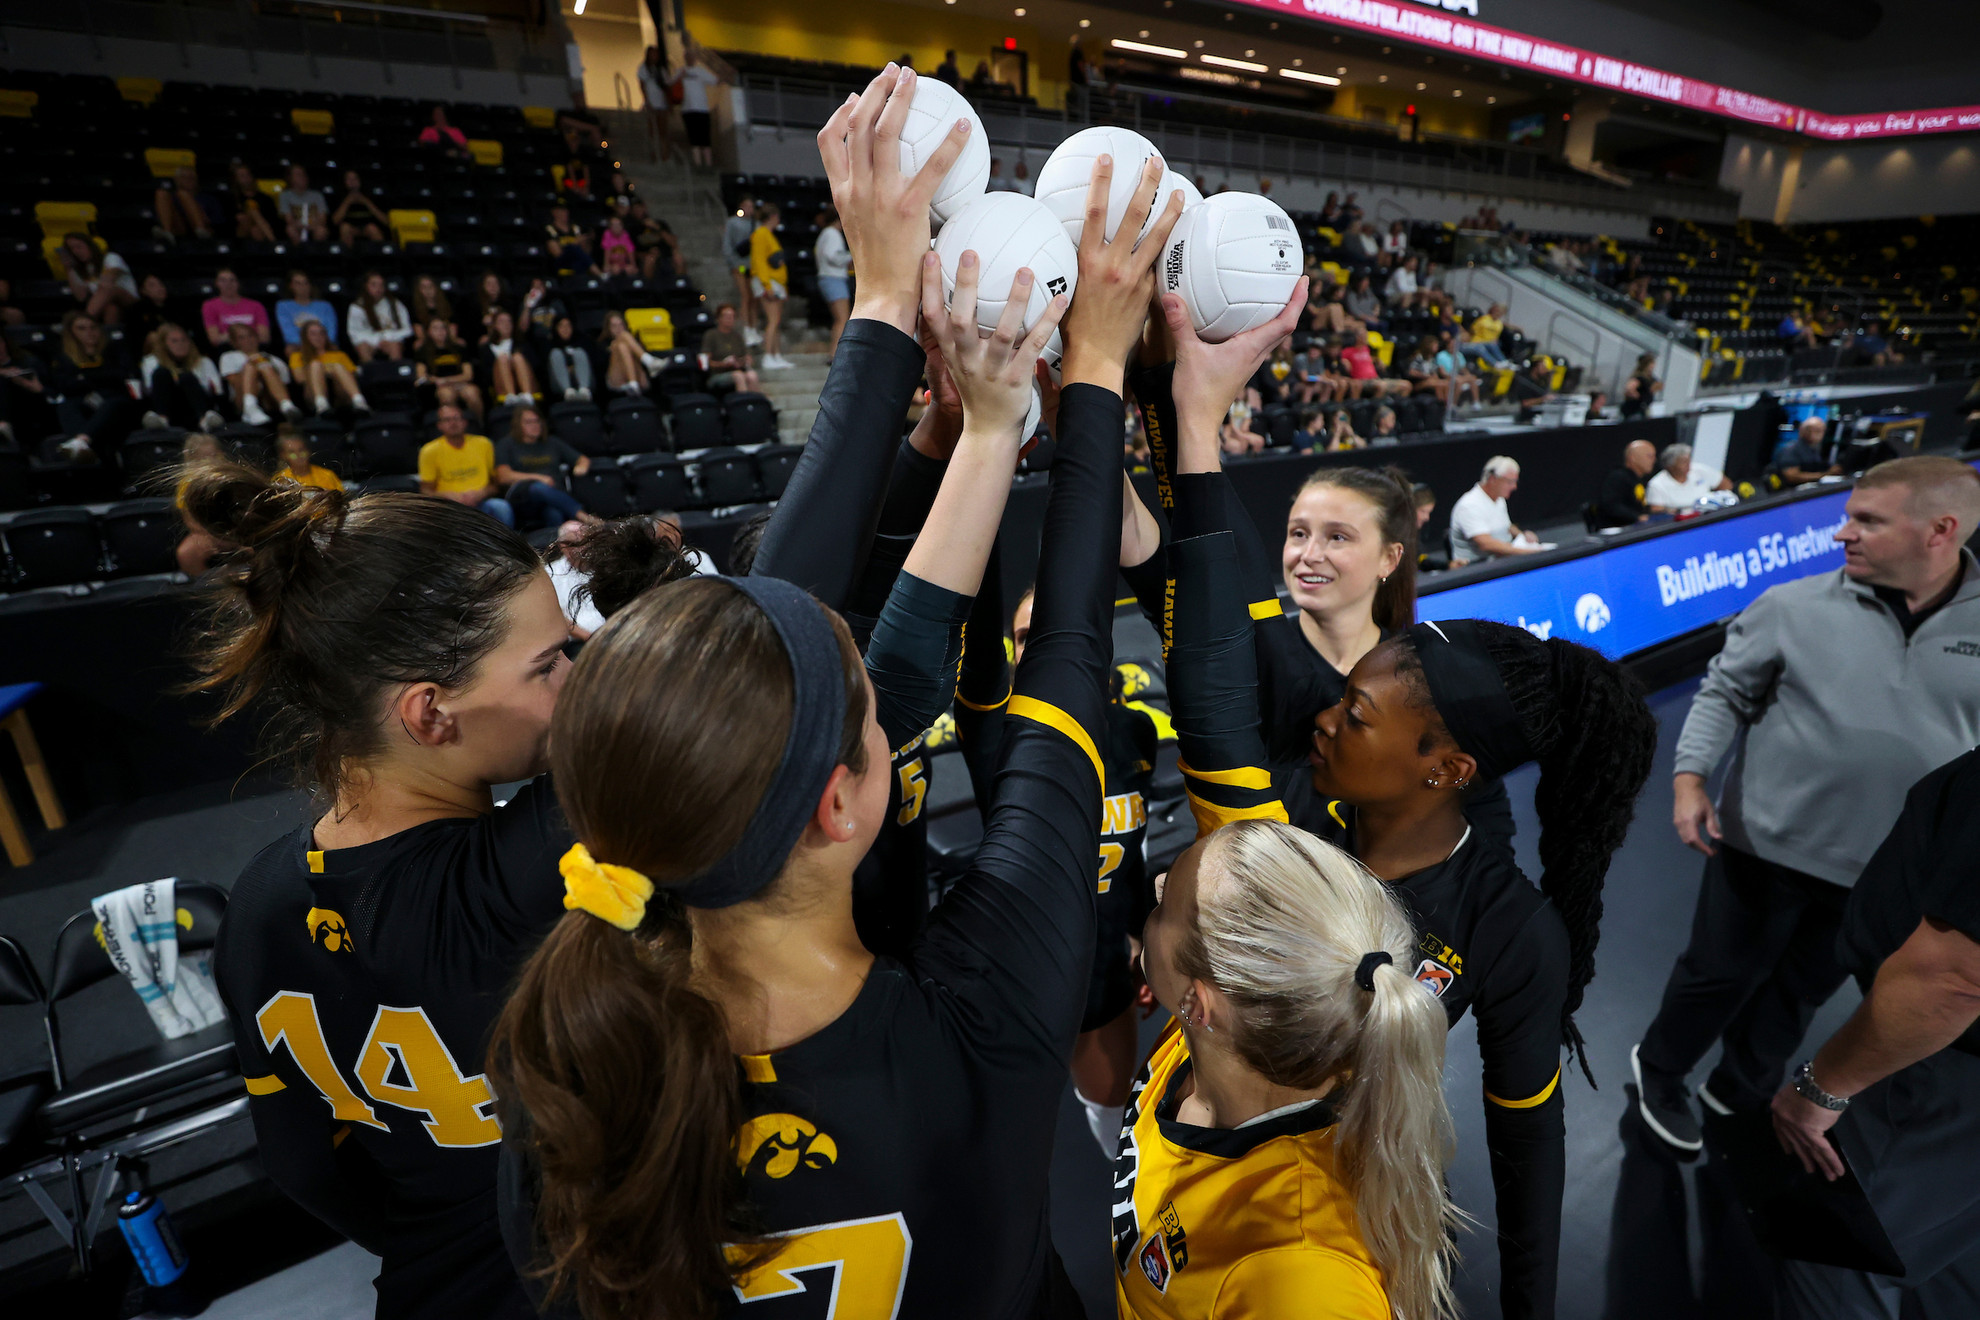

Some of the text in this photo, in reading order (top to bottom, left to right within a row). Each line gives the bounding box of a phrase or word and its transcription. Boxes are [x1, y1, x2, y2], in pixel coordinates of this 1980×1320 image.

[1452, 23, 1475, 49] ON
[1475, 28, 1502, 56] THE
[1501, 35, 1534, 63] NEW
[1593, 56, 1624, 87] KIM
[1145, 403, 1174, 508] HAWKEYES
[1656, 551, 1749, 607] Building
[1747, 548, 1763, 577] a
[1758, 532, 1789, 573] 5G
[255, 990, 503, 1149] 14
[721, 1211, 913, 1320] 7
